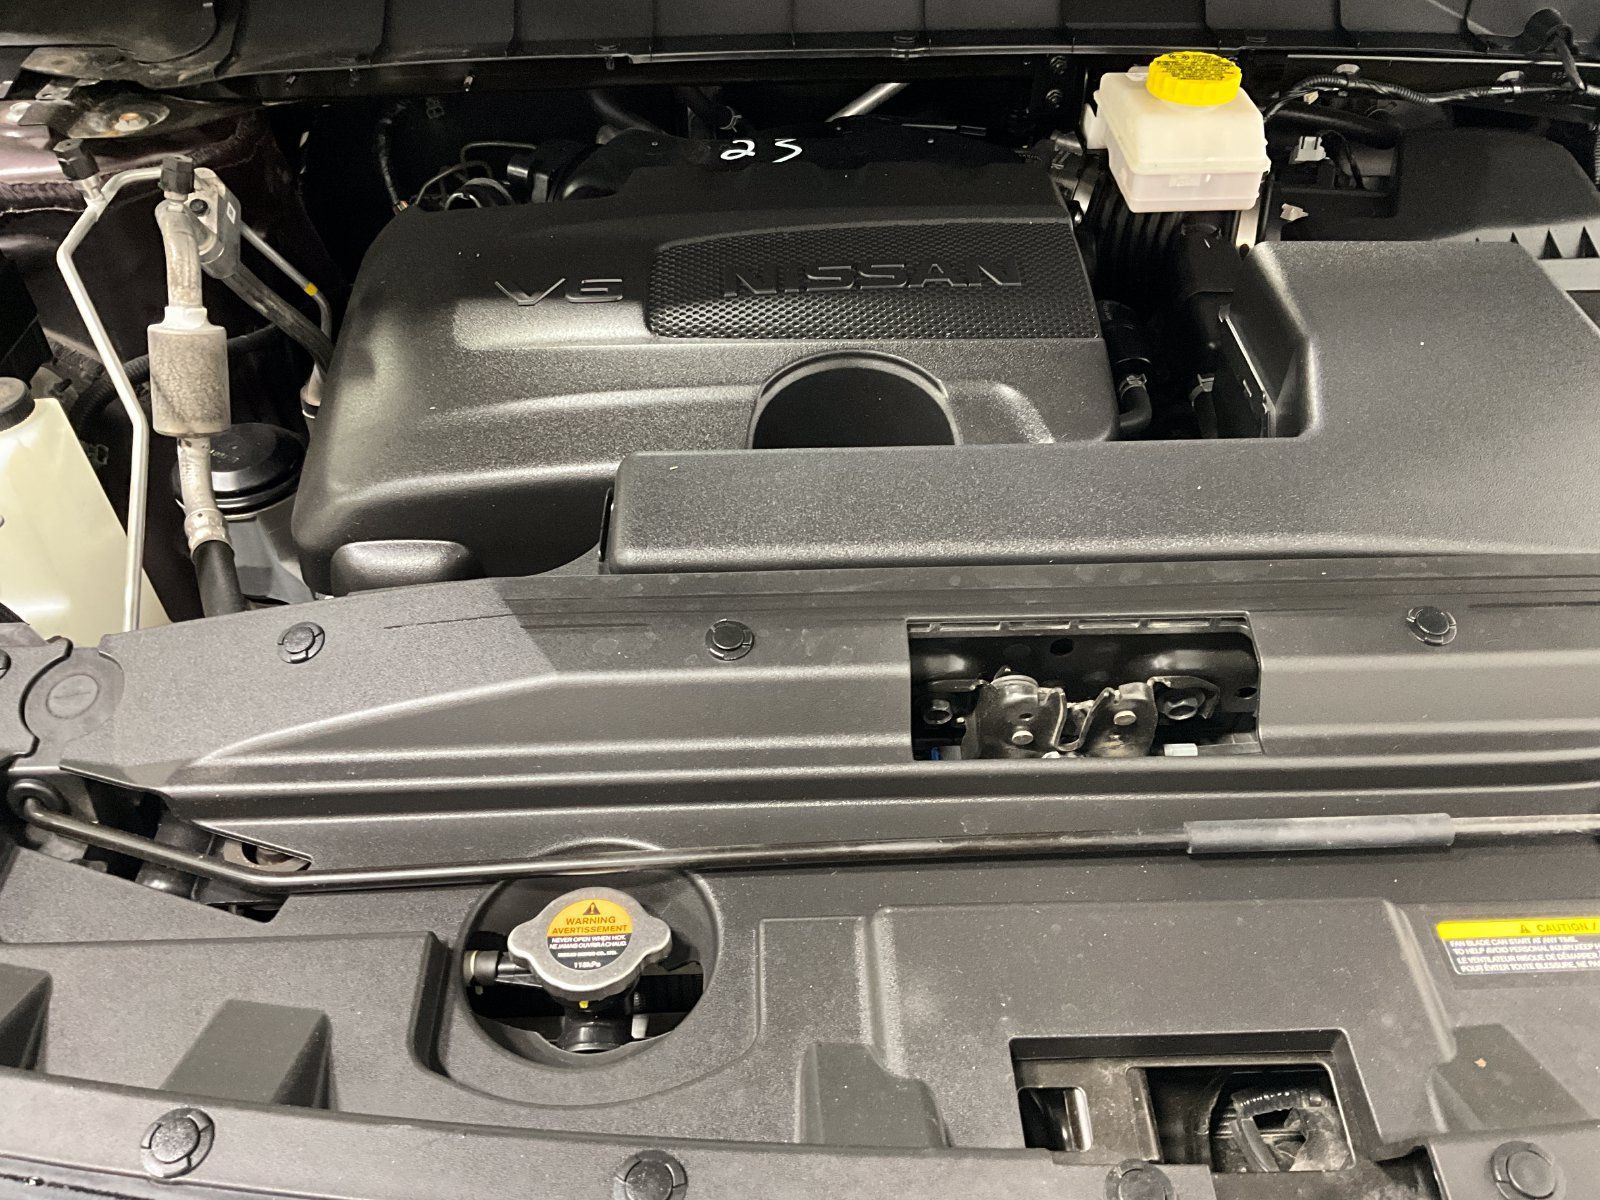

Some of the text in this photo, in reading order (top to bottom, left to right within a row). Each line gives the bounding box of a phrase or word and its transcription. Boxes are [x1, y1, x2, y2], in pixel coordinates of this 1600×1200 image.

[723, 264, 1022, 298] NISSAN
[566, 916, 616, 925] WARNING
[552, 925, 628, 934] AVERTISSEMENT
[1536, 922, 1589, 933] CAUTION
[1509, 937, 1531, 945] START
[1509, 945, 1549, 953] PERSONAL
[1468, 955, 1516, 963] VENTILATEUR
[1516, 954, 1545, 962] RISQUE
[1545, 953, 1557, 961] DE
[1460, 965, 1483, 973] POUR
[1510, 962, 1536, 970] TOUTE
